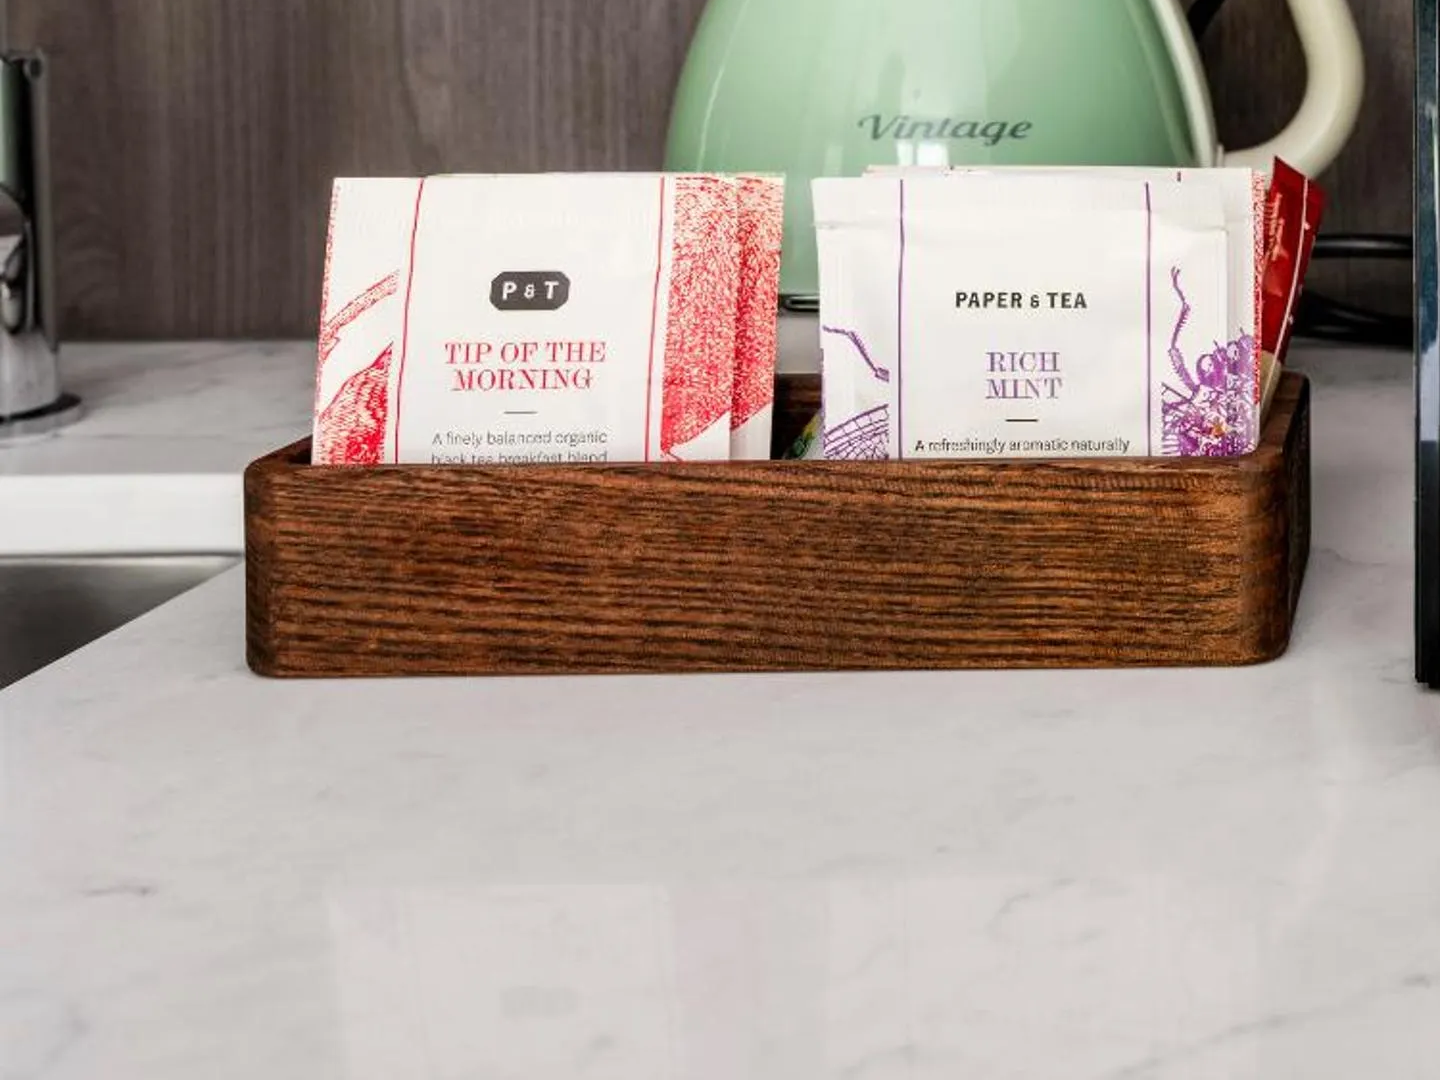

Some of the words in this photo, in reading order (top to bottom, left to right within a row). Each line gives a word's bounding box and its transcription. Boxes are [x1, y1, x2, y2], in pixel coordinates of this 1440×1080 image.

[857, 114, 1033, 147] Vintage
[502, 281, 517, 301] P
[544, 281, 559, 299] T
[955, 291, 1023, 309] PAPER
[1029, 294, 1040, 309] &
[1046, 291, 1088, 309] TEA
[444, 342, 493, 365] TIP
[500, 342, 539, 364] OF
[546, 341, 606, 363] THE
[985, 351, 1061, 373] RICH
[451, 368, 593, 391] MORNING
[985, 377, 1063, 399] MINT
[431, 433, 443, 446] A
[446, 431, 483, 449] finely
[487, 430, 551, 446] balanced
[554, 431, 608, 448] organic
[914, 439, 925, 452] A
[928, 437, 1005, 455] refreshingly
[1009, 438, 1068, 452] aromatic
[1071, 437, 1131, 454] naturally
